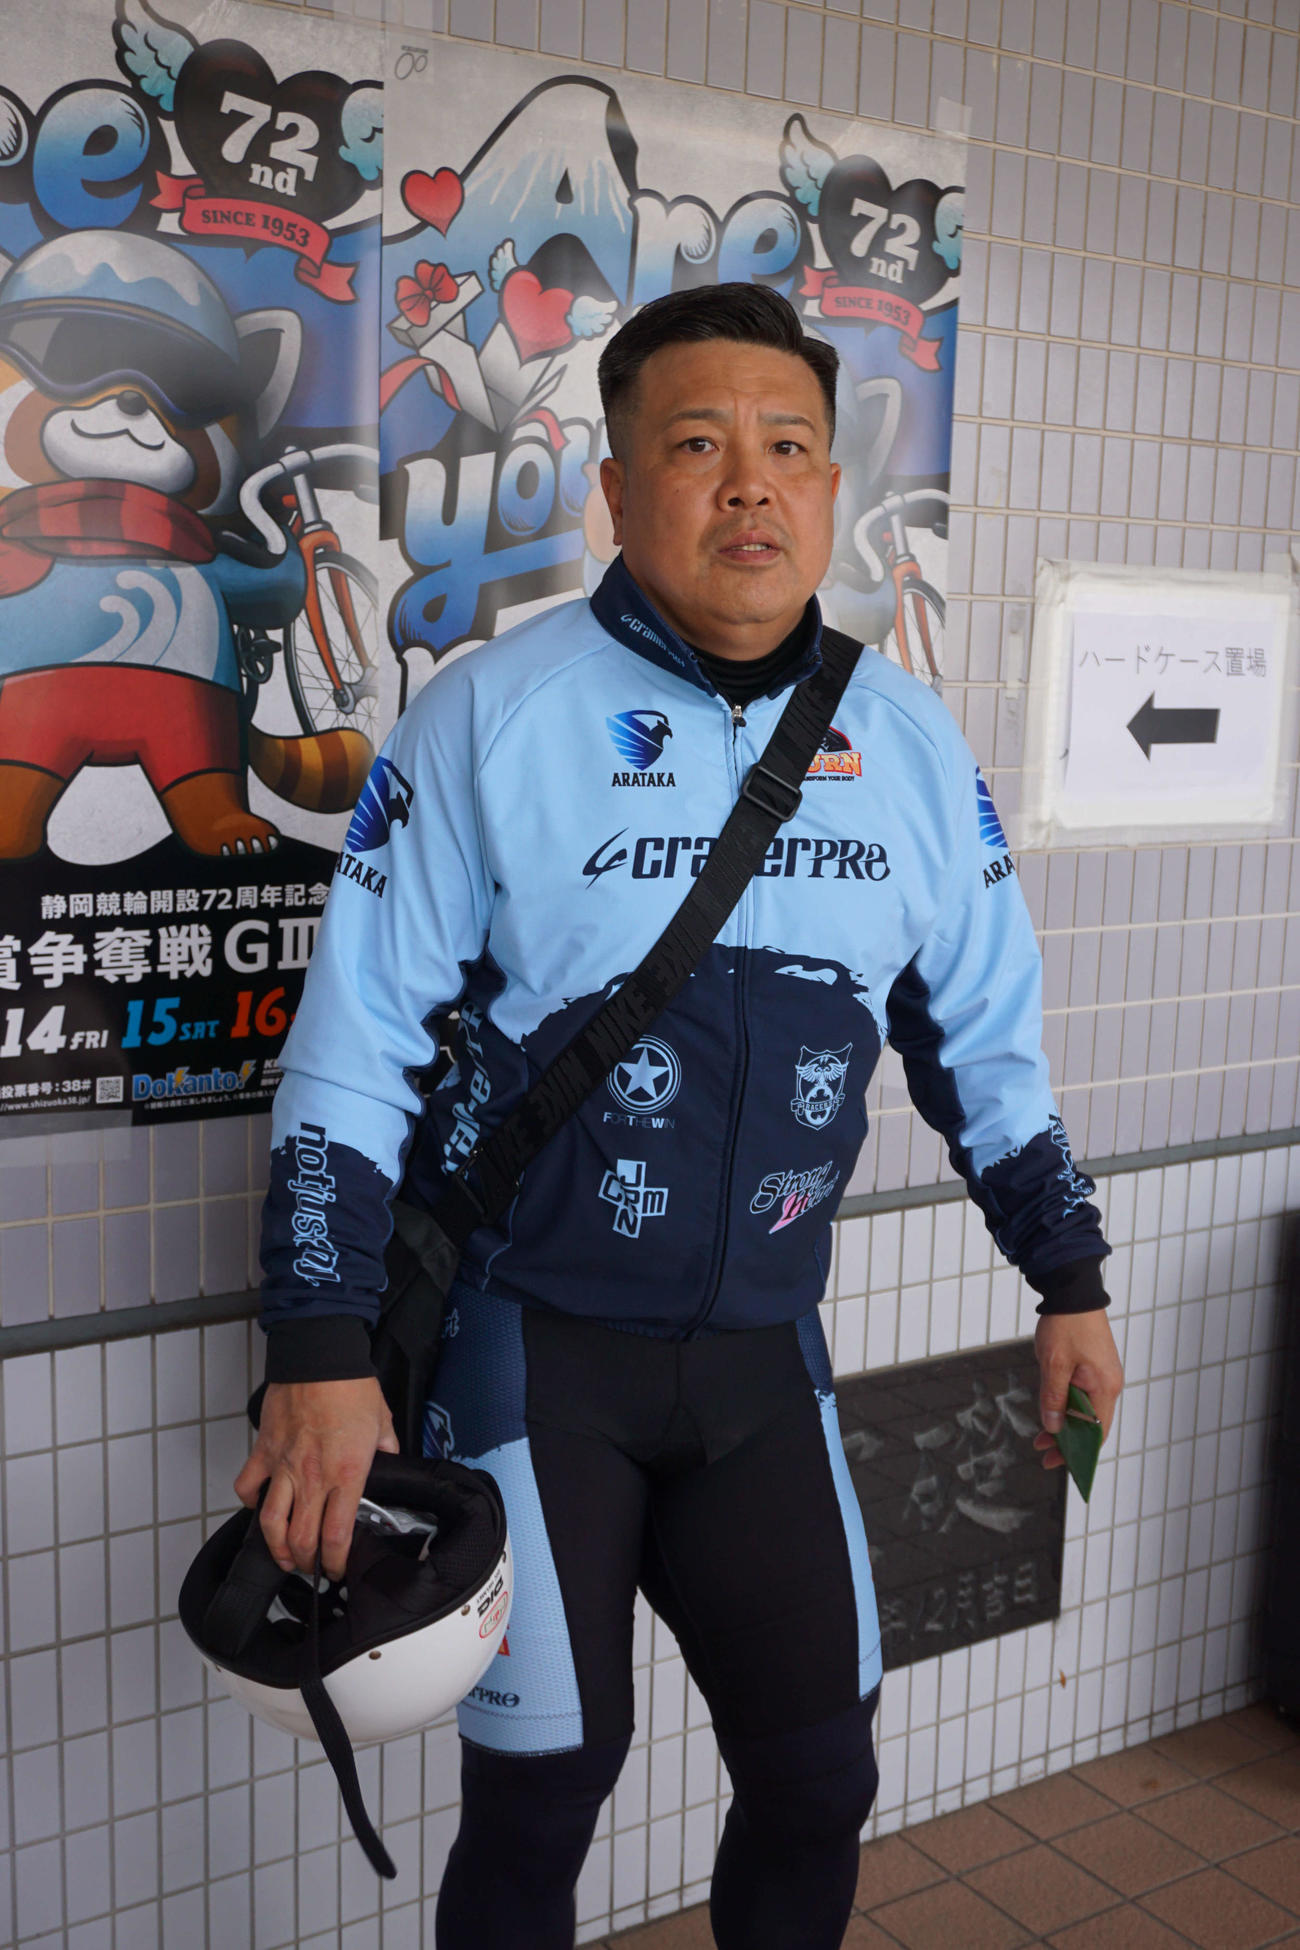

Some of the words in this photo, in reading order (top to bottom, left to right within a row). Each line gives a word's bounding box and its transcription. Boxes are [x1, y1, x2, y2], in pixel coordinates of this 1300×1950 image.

[219, 91, 320, 182] 72
[249, 160, 297, 196] nd
[201, 206, 256, 228] SINCE
[261, 211, 310, 247] 1953
[850, 197, 921, 271] 72
[869, 255, 904, 284] nd
[834, 295, 874, 310] SINCE
[877, 300, 911, 326] 1953
[1079, 645, 1267, 677] ハードケース置場
[611, 773, 676, 787] ARATAKA
[41, 882, 330, 919] 静岡競輪開設72周年記念
[0, 1005, 67, 1057] 14
[69, 1030, 109, 1050] FRI
[121, 997, 181, 1048] 15
[178, 1020, 220, 1042] SAT
[230, 986, 287, 1038] 16
